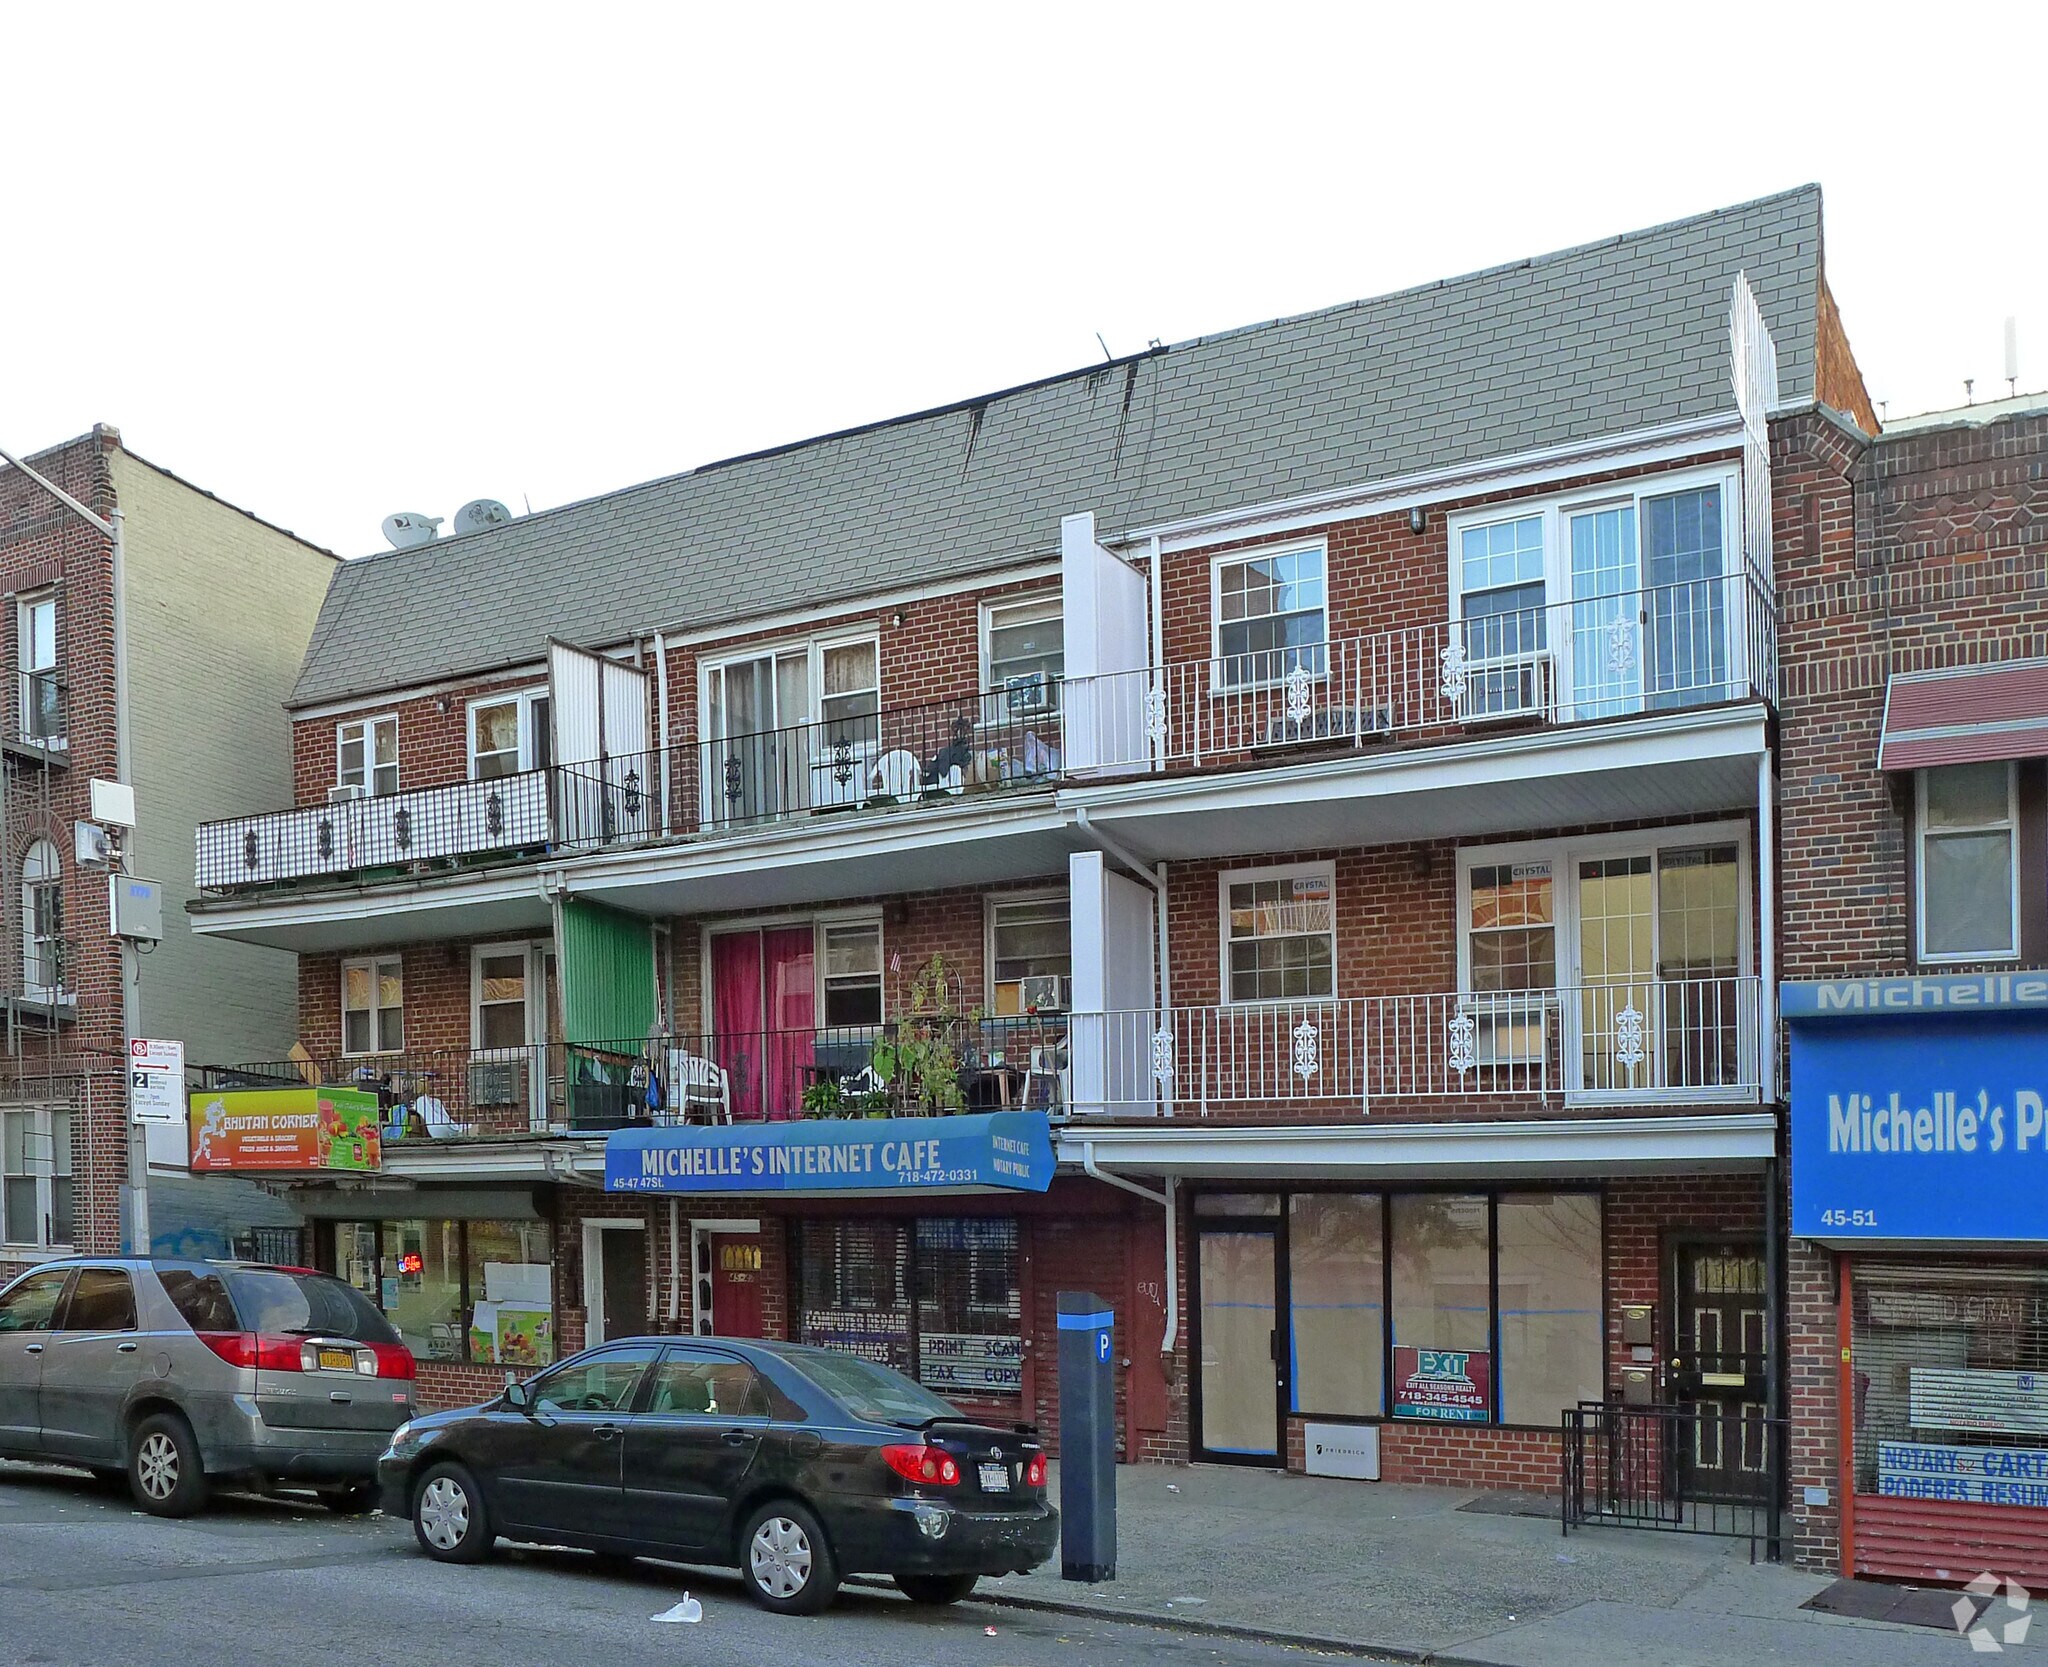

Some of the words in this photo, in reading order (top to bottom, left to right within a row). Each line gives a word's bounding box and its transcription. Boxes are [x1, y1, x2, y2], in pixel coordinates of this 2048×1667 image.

[1512, 866, 1551, 876] CRYSTAL
[1294, 881, 1328, 890] CRYSTAL
[136, 1074, 144, 1087] 2
[224, 1115, 269, 1130] BHUTAN
[272, 1113, 318, 1129] CORNER
[1828, 1089, 2004, 1153] Michelle's
[992, 1135, 1016, 1154] INTERNET
[1017, 1141, 1030, 1157] CAFE
[641, 1146, 764, 1177] MICHELLE'S
[769, 1143, 873, 1174] INTERNET
[881, 1140, 941, 1171] CAFE
[899, 1169, 978, 1183] 718-472-0331
[993, 1158, 1012, 1174] NOTARY
[1012, 1161, 1030, 1178] PUBLIC
[613, 1178, 638, 1189] 45-47
[1821, 1209, 1878, 1227] 45-51
[805, 1310, 865, 1332] COMPUTER
[866, 1312, 907, 1333] REPAIR
[929, 1339, 966, 1356] PRINT
[985, 1341, 1021, 1356] SCAN
[1100, 1334, 1109, 1358] P
[929, 1365, 955, 1380] FAX
[985, 1368, 1021, 1383] COPY
[1406, 1381, 1418, 1389] EXIT
[1418, 1382, 1428, 1390] ALL
[1429, 1383, 1455, 1391] SEASONS
[1455, 1385, 1476, 1393] REALTY
[1399, 1391, 1483, 1405] 718-345-4545
[1416, 1407, 1438, 1417] FOR
[1440, 1407, 1473, 1420] RENT
[1325, 1447, 1365, 1455] FRIEDRICH
[1885, 1447, 1958, 1472] NOTARY
[1982, 1451, 2048, 1477] CART
[1884, 1476, 1968, 1501] PODERES
